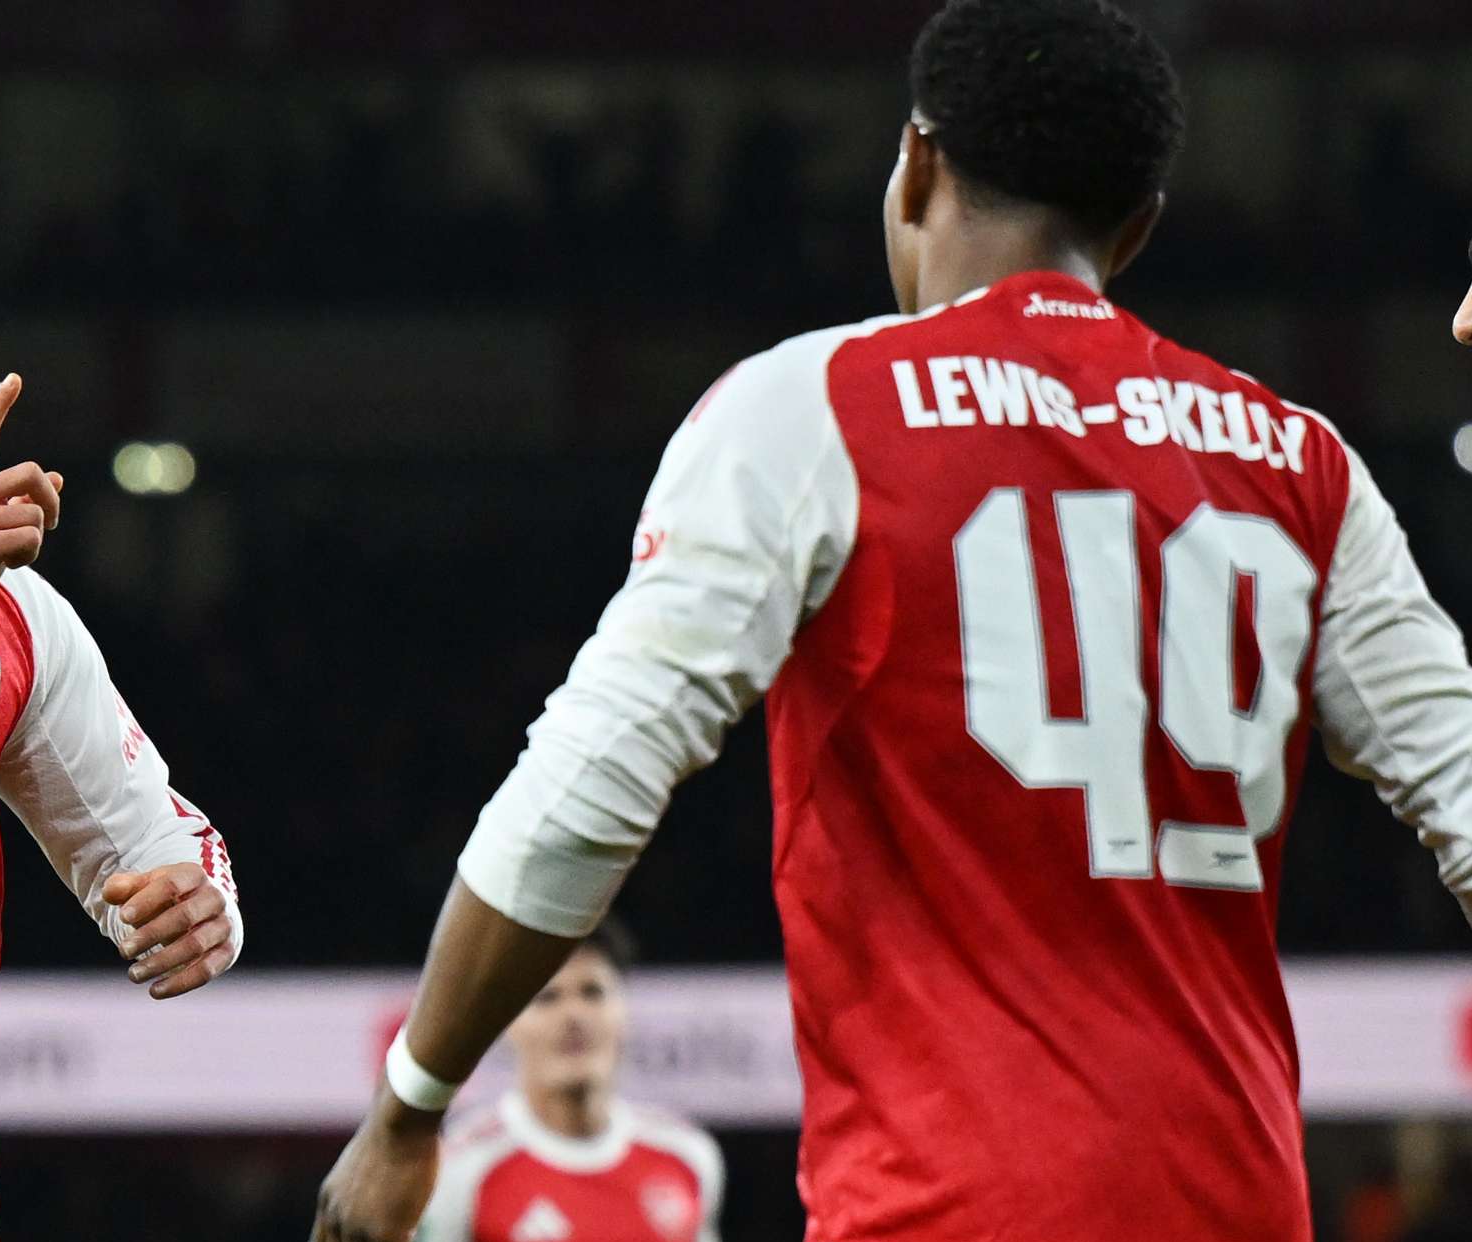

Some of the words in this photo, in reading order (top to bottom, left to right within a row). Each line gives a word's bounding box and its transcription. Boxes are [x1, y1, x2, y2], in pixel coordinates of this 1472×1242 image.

[1023, 292, 1116, 320] Arsenal
[891, 355, 1308, 475] LEWIS-SKELLY
[952, 486, 1319, 893] 49
